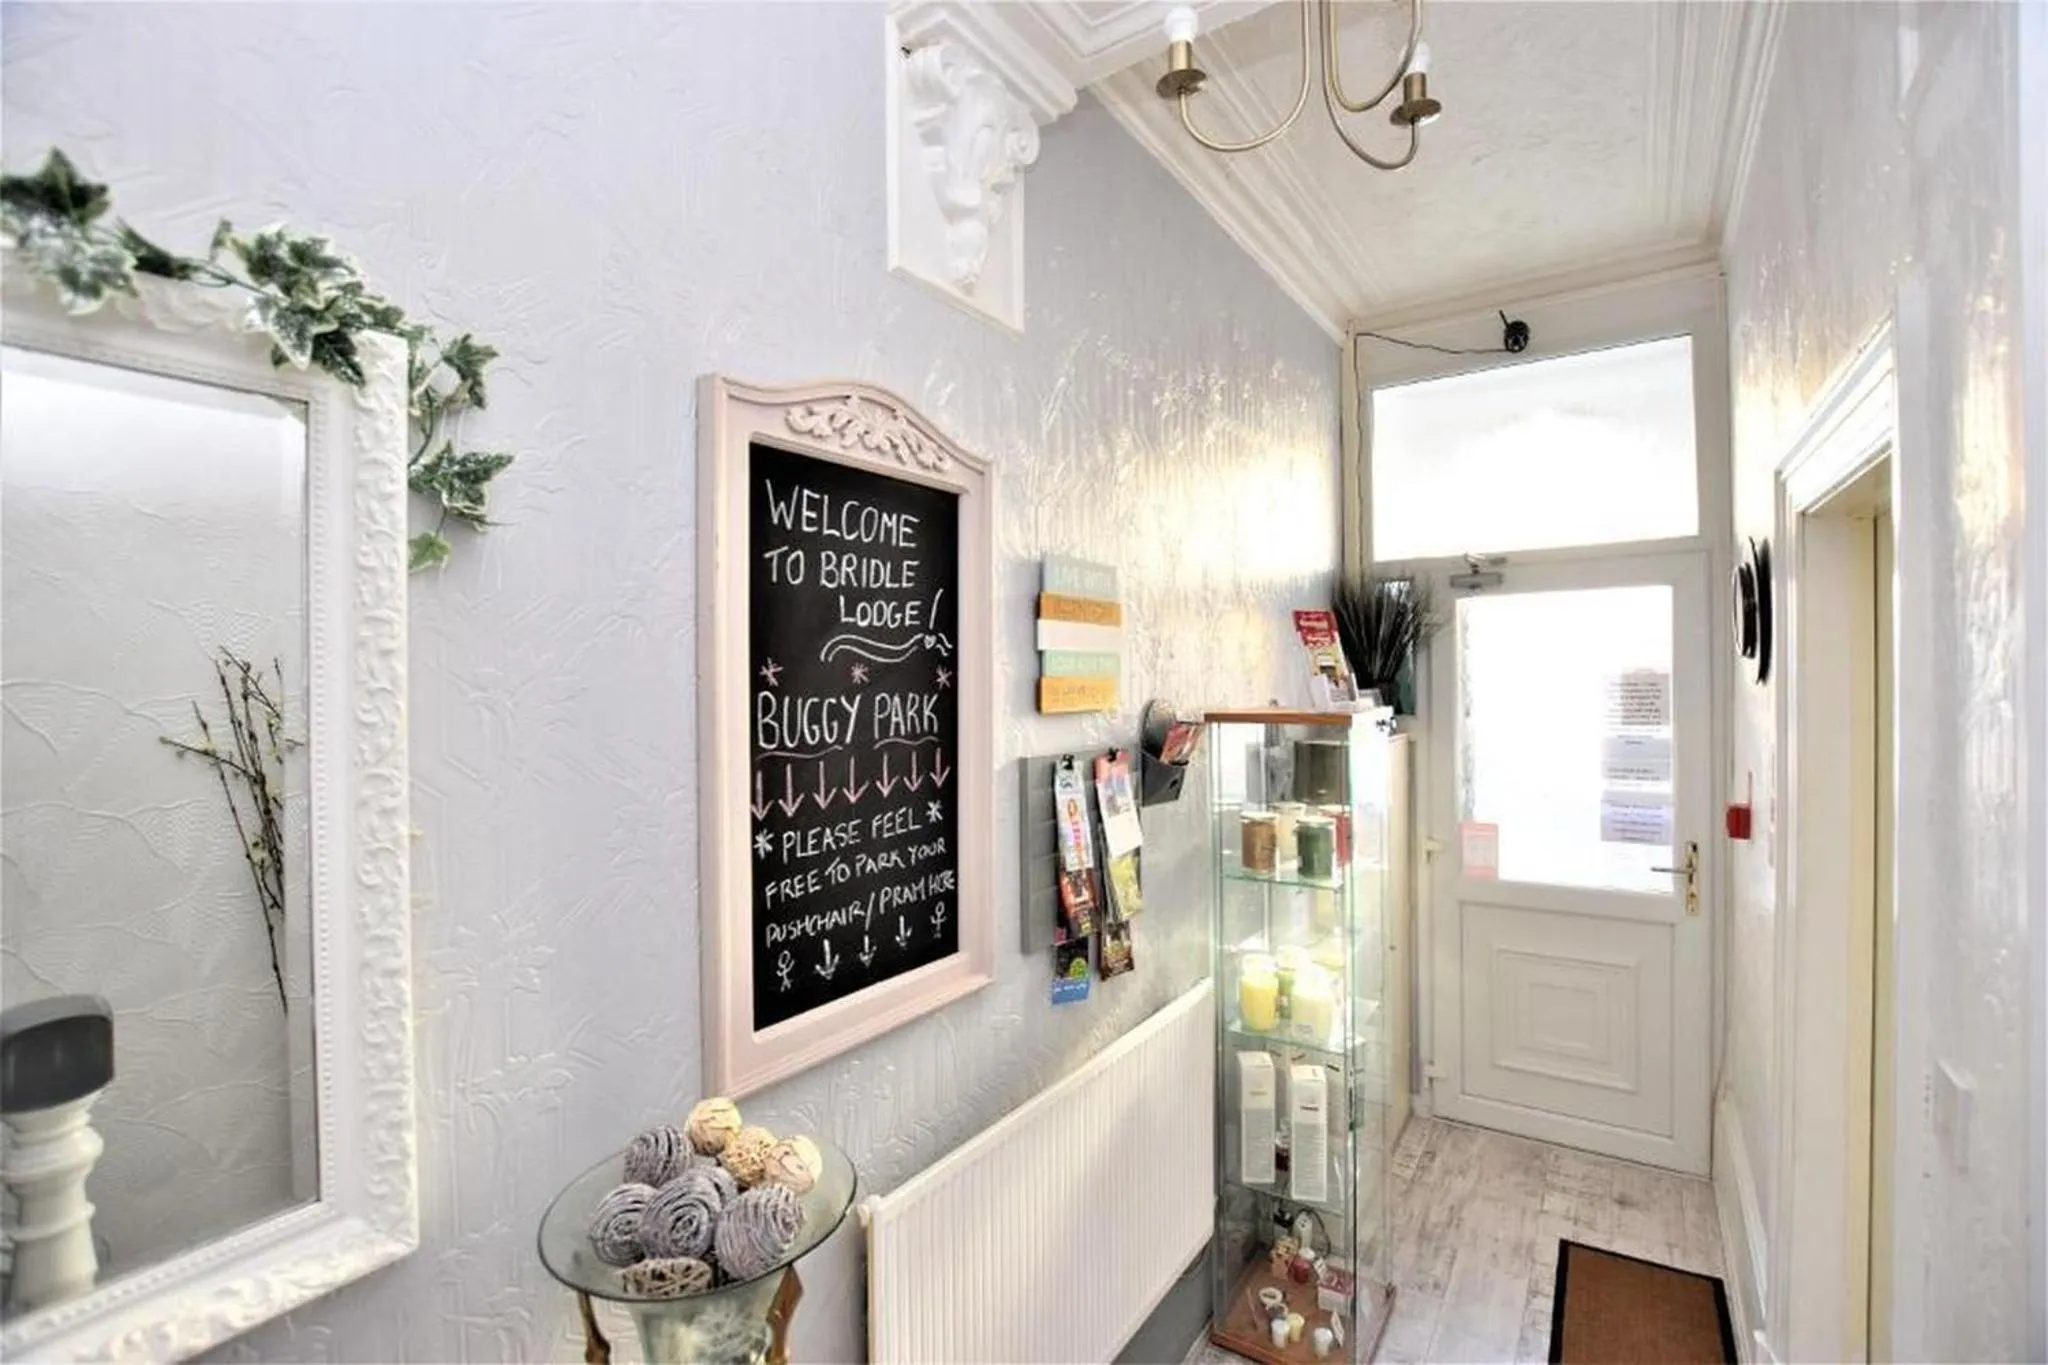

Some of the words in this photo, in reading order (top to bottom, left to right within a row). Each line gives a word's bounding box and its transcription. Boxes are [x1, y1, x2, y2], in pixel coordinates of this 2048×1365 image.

[765, 479, 920, 548] WELCOME
[764, 546, 805, 585] TO
[819, 550, 920, 588] BRIDLE
[757, 690, 861, 750] BUGGY
[874, 692, 939, 739] PARK
[782, 819, 862, 864] PLEASE
[871, 807, 922, 840] FEEL
[765, 871, 822, 909] FREE
[825, 856, 851, 886] TO
[856, 852, 906, 878] PARK
[908, 837, 947, 866] YOUR
